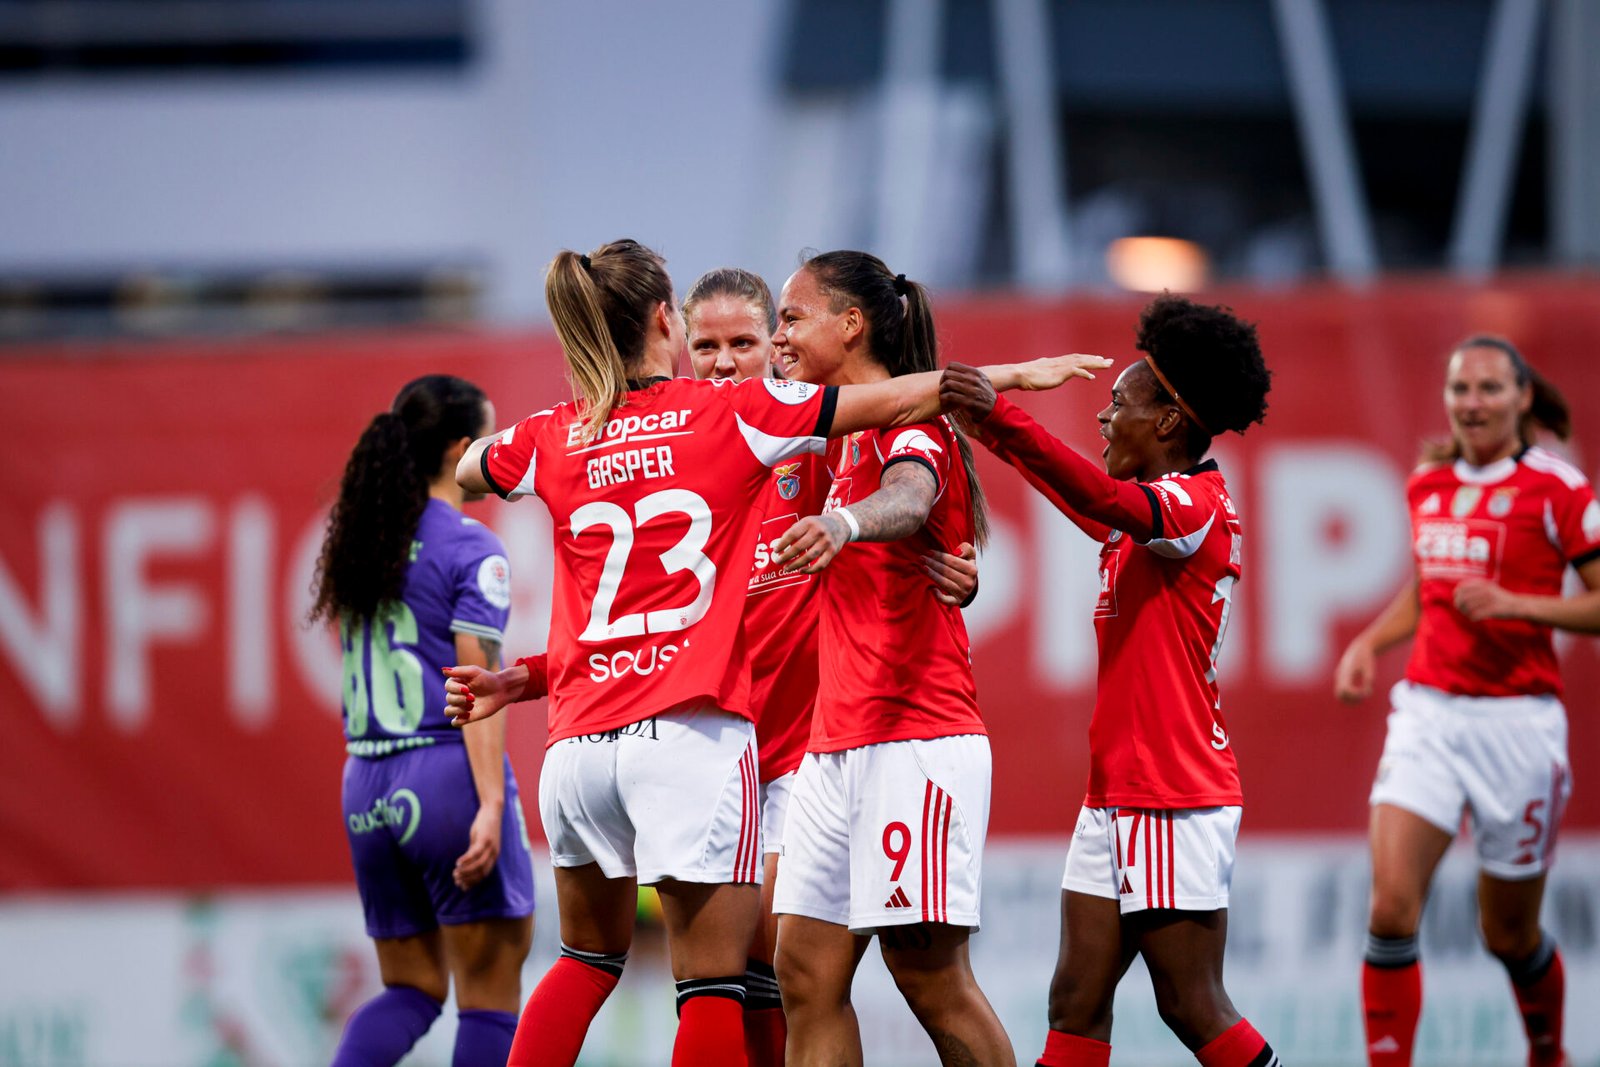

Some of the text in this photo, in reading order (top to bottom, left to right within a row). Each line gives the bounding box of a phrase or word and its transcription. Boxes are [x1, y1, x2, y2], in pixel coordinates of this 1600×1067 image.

[566, 409, 692, 447] Eropcar
[587, 445, 675, 490] GASPER
[569, 488, 717, 642] 23
[761, 573, 776, 582] sua
[1111, 808, 1144, 870] 17
[1519, 799, 1544, 848] 5
[882, 821, 912, 882] 9
